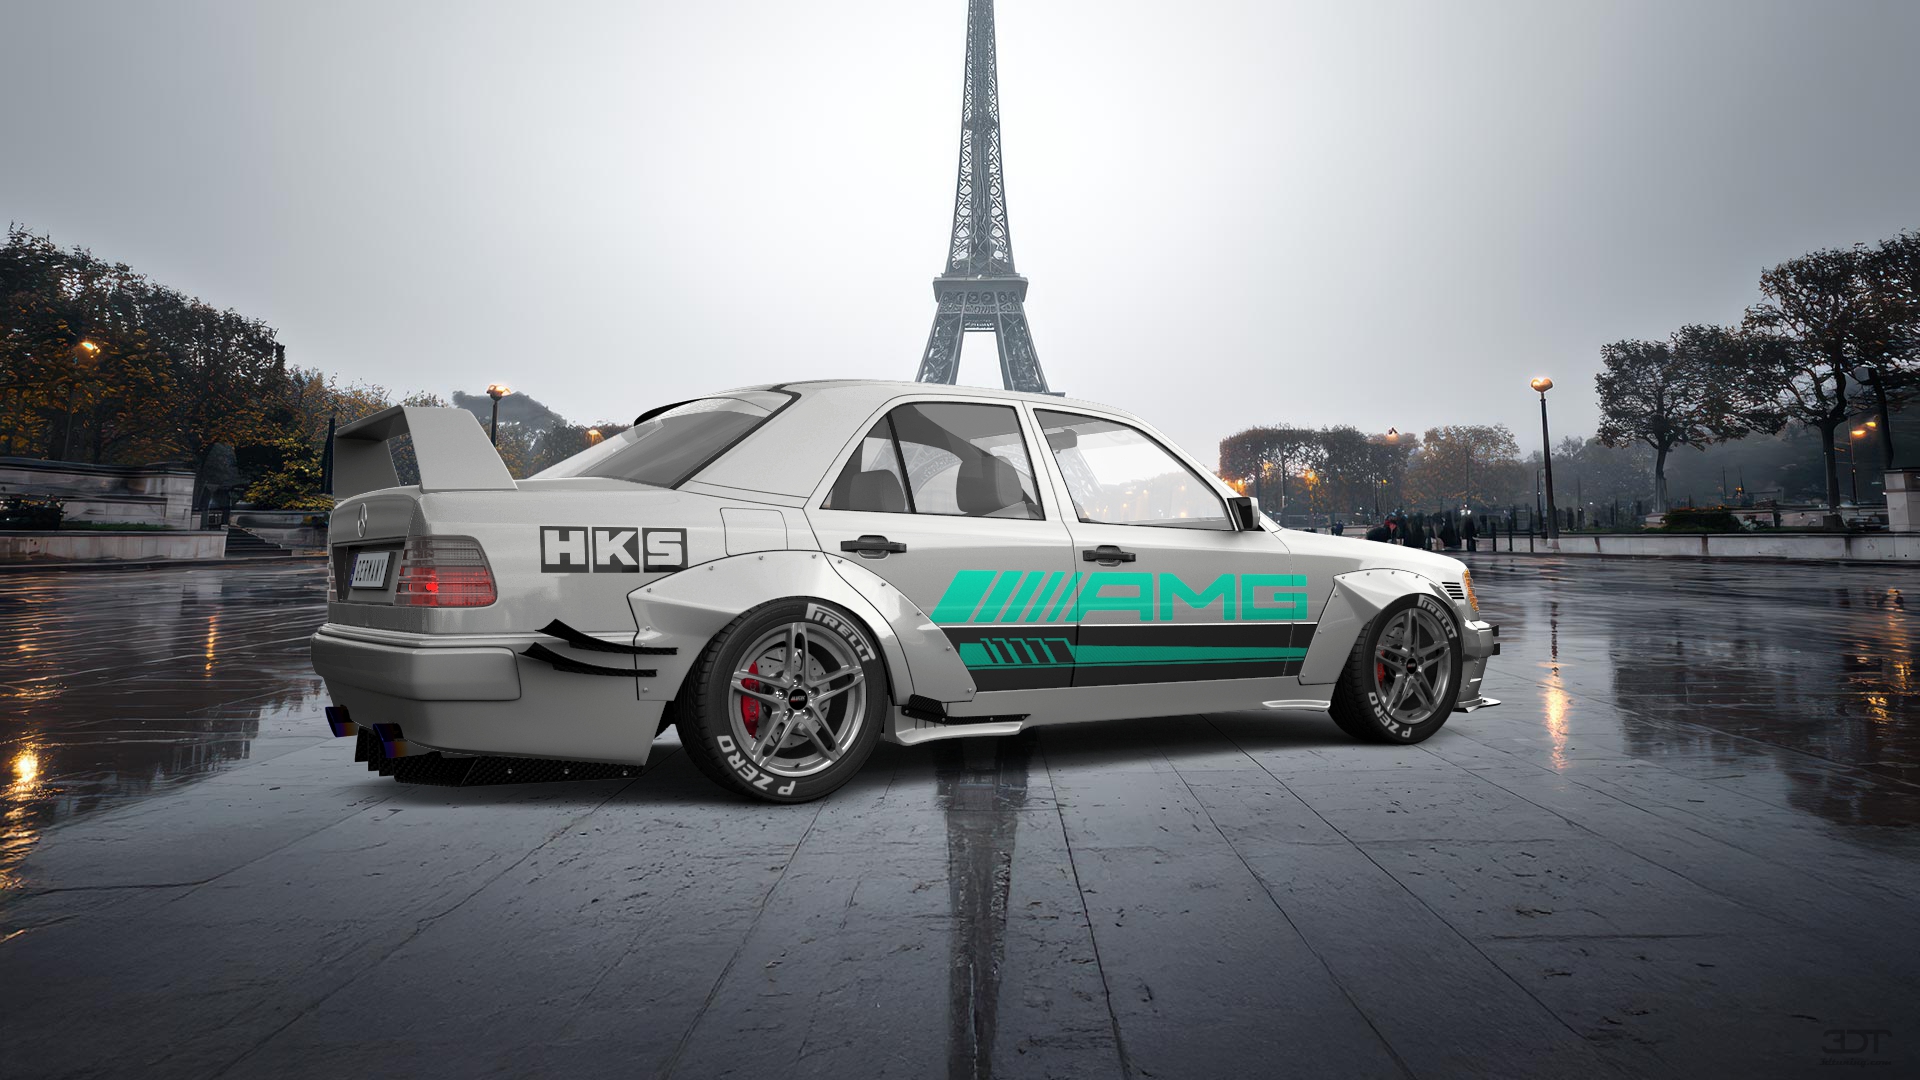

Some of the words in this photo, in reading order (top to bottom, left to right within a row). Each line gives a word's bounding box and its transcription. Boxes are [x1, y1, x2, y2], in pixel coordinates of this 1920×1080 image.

[543, 528, 684, 567] HKS
[355, 559, 386, 582] GERMANY
[1065, 571, 1308, 622] AMG
[1417, 594, 1458, 639] PIRELLI
[805, 602, 876, 662] PIRELLI
[1368, 691, 1400, 734] ZERO
[1401, 726, 1412, 738] P
[716, 735, 774, 791] ZERO
[777, 780, 796, 796] P
